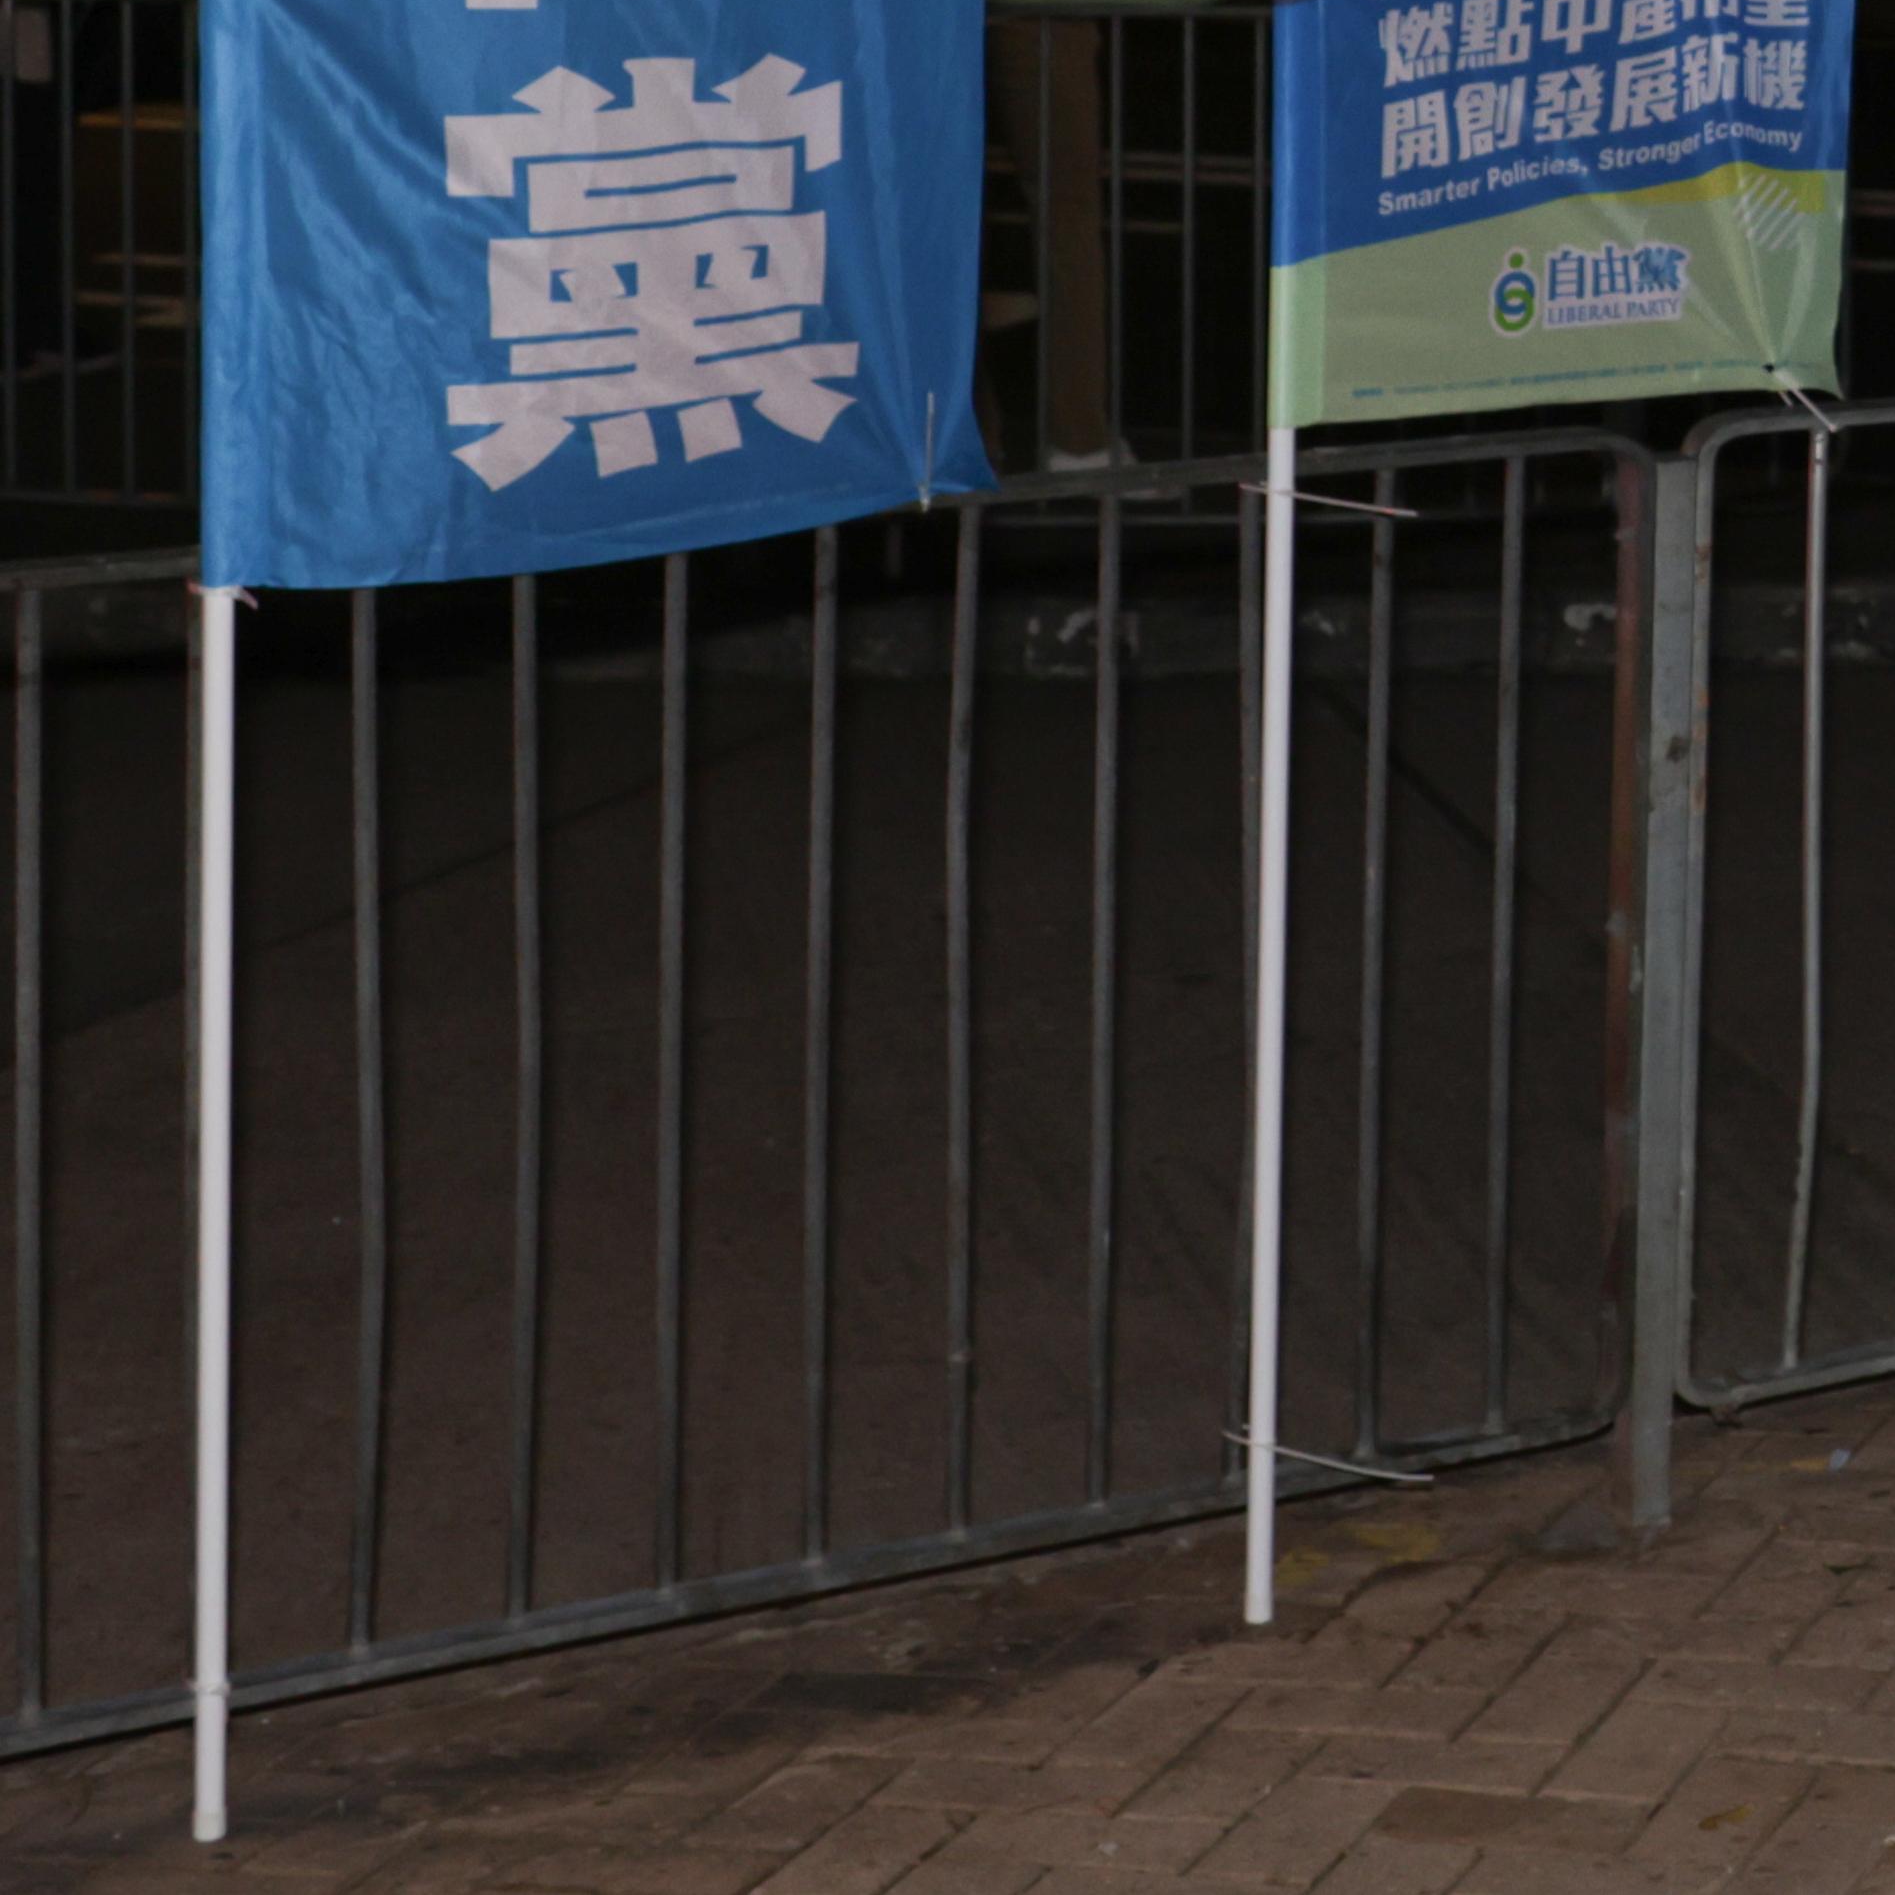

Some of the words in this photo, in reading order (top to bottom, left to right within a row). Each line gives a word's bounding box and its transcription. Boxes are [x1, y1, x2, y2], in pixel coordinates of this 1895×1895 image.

[1380, 31, 1808, 179] 開創發展新機
[1377, 173, 1480, 217] Smarter
[1485, 152, 1588, 192] Policies,
[1597, 131, 1700, 172] Stronger
[1703, 118, 1803, 153] Economy
[1548, 246, 1687, 302] 自由黨
